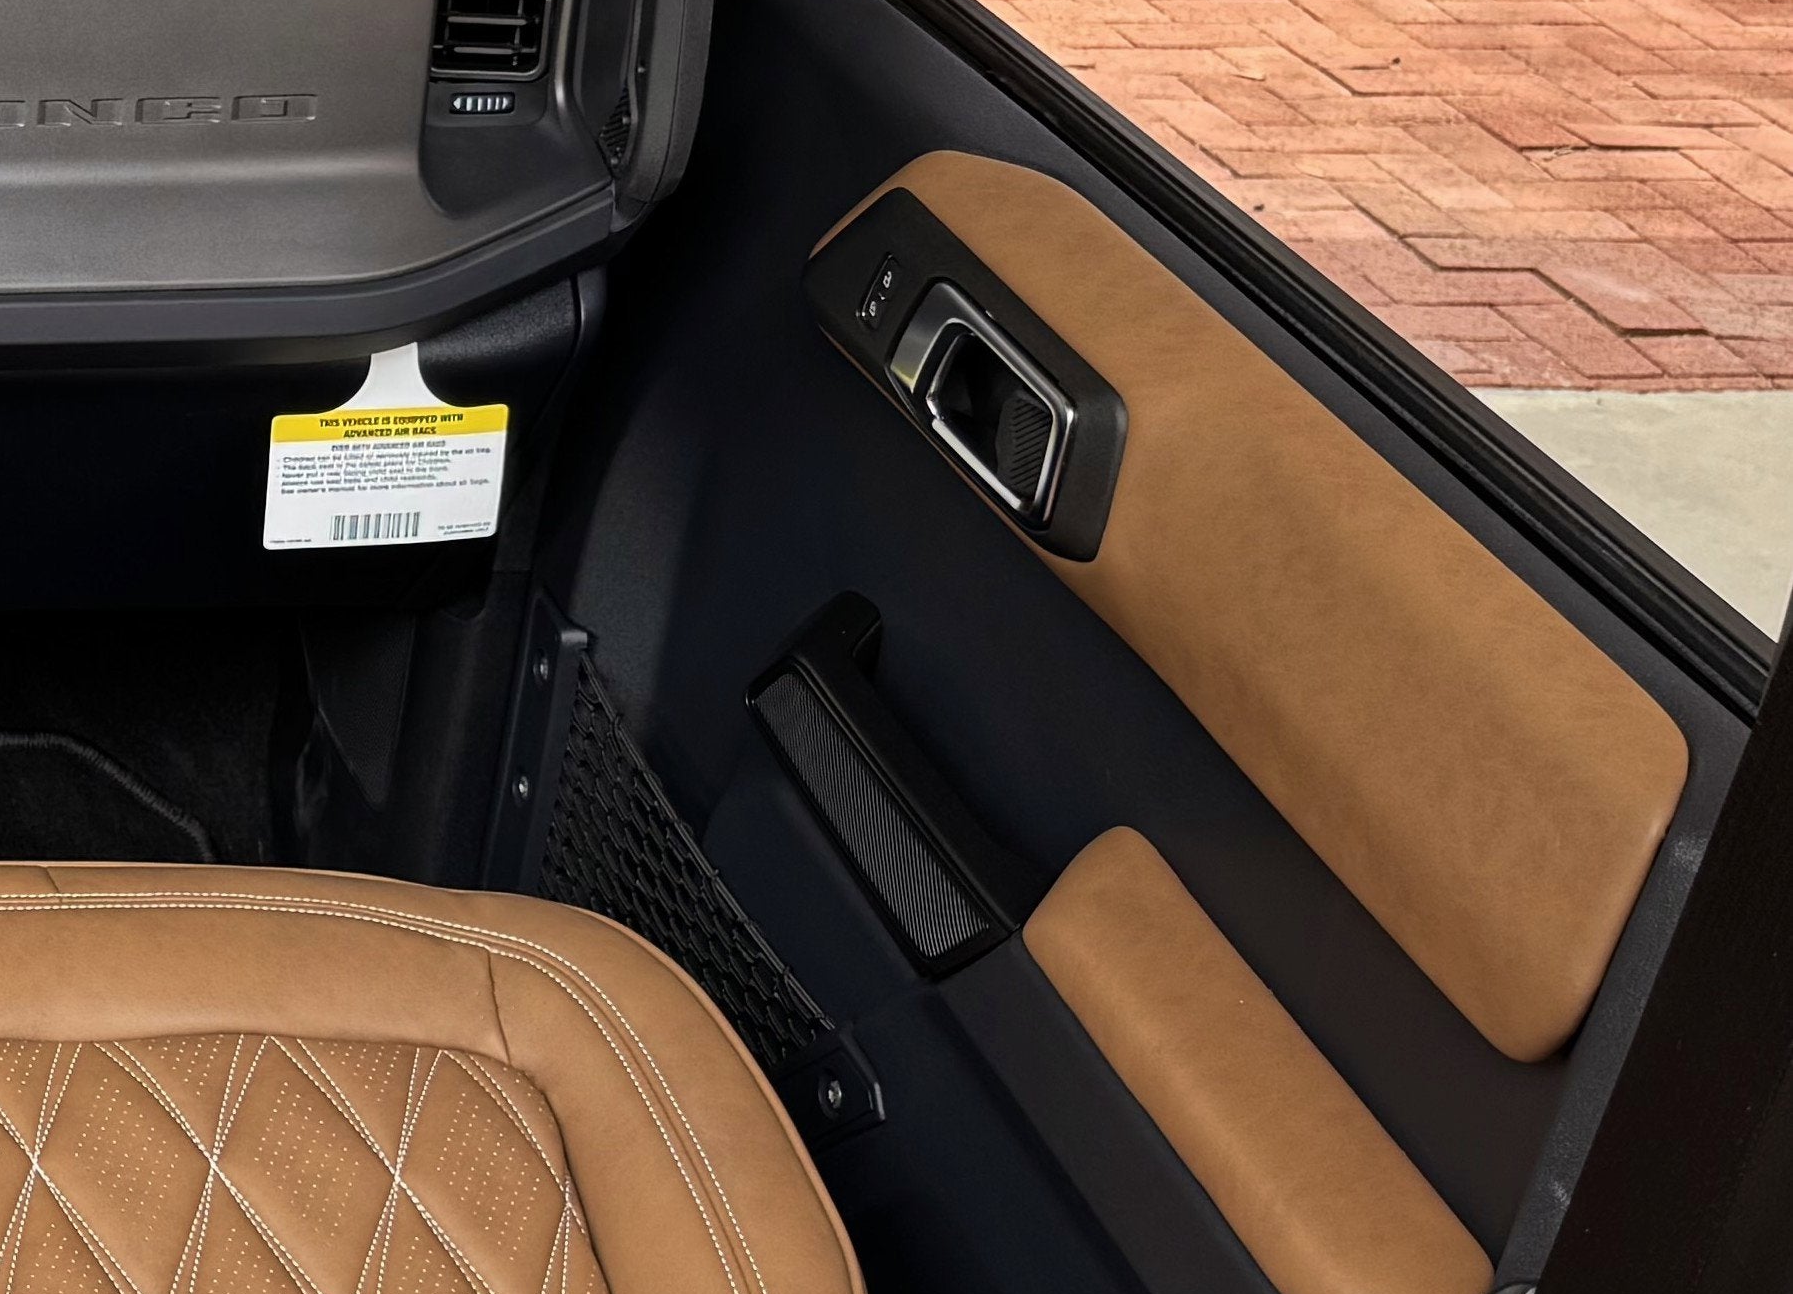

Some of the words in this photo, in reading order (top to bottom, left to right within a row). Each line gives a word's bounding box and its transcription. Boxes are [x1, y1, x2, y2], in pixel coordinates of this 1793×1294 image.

[320, 418, 340, 427] THIS
[342, 417, 380, 427] VEHICLE
[381, 416, 391, 425] IS
[393, 415, 438, 425] EQUIPPED
[440, 413, 464, 423] WITH
[343, 428, 392, 438] ADVANCED
[394, 427, 410, 437] AIR
[413, 426, 437, 436] BAGS
